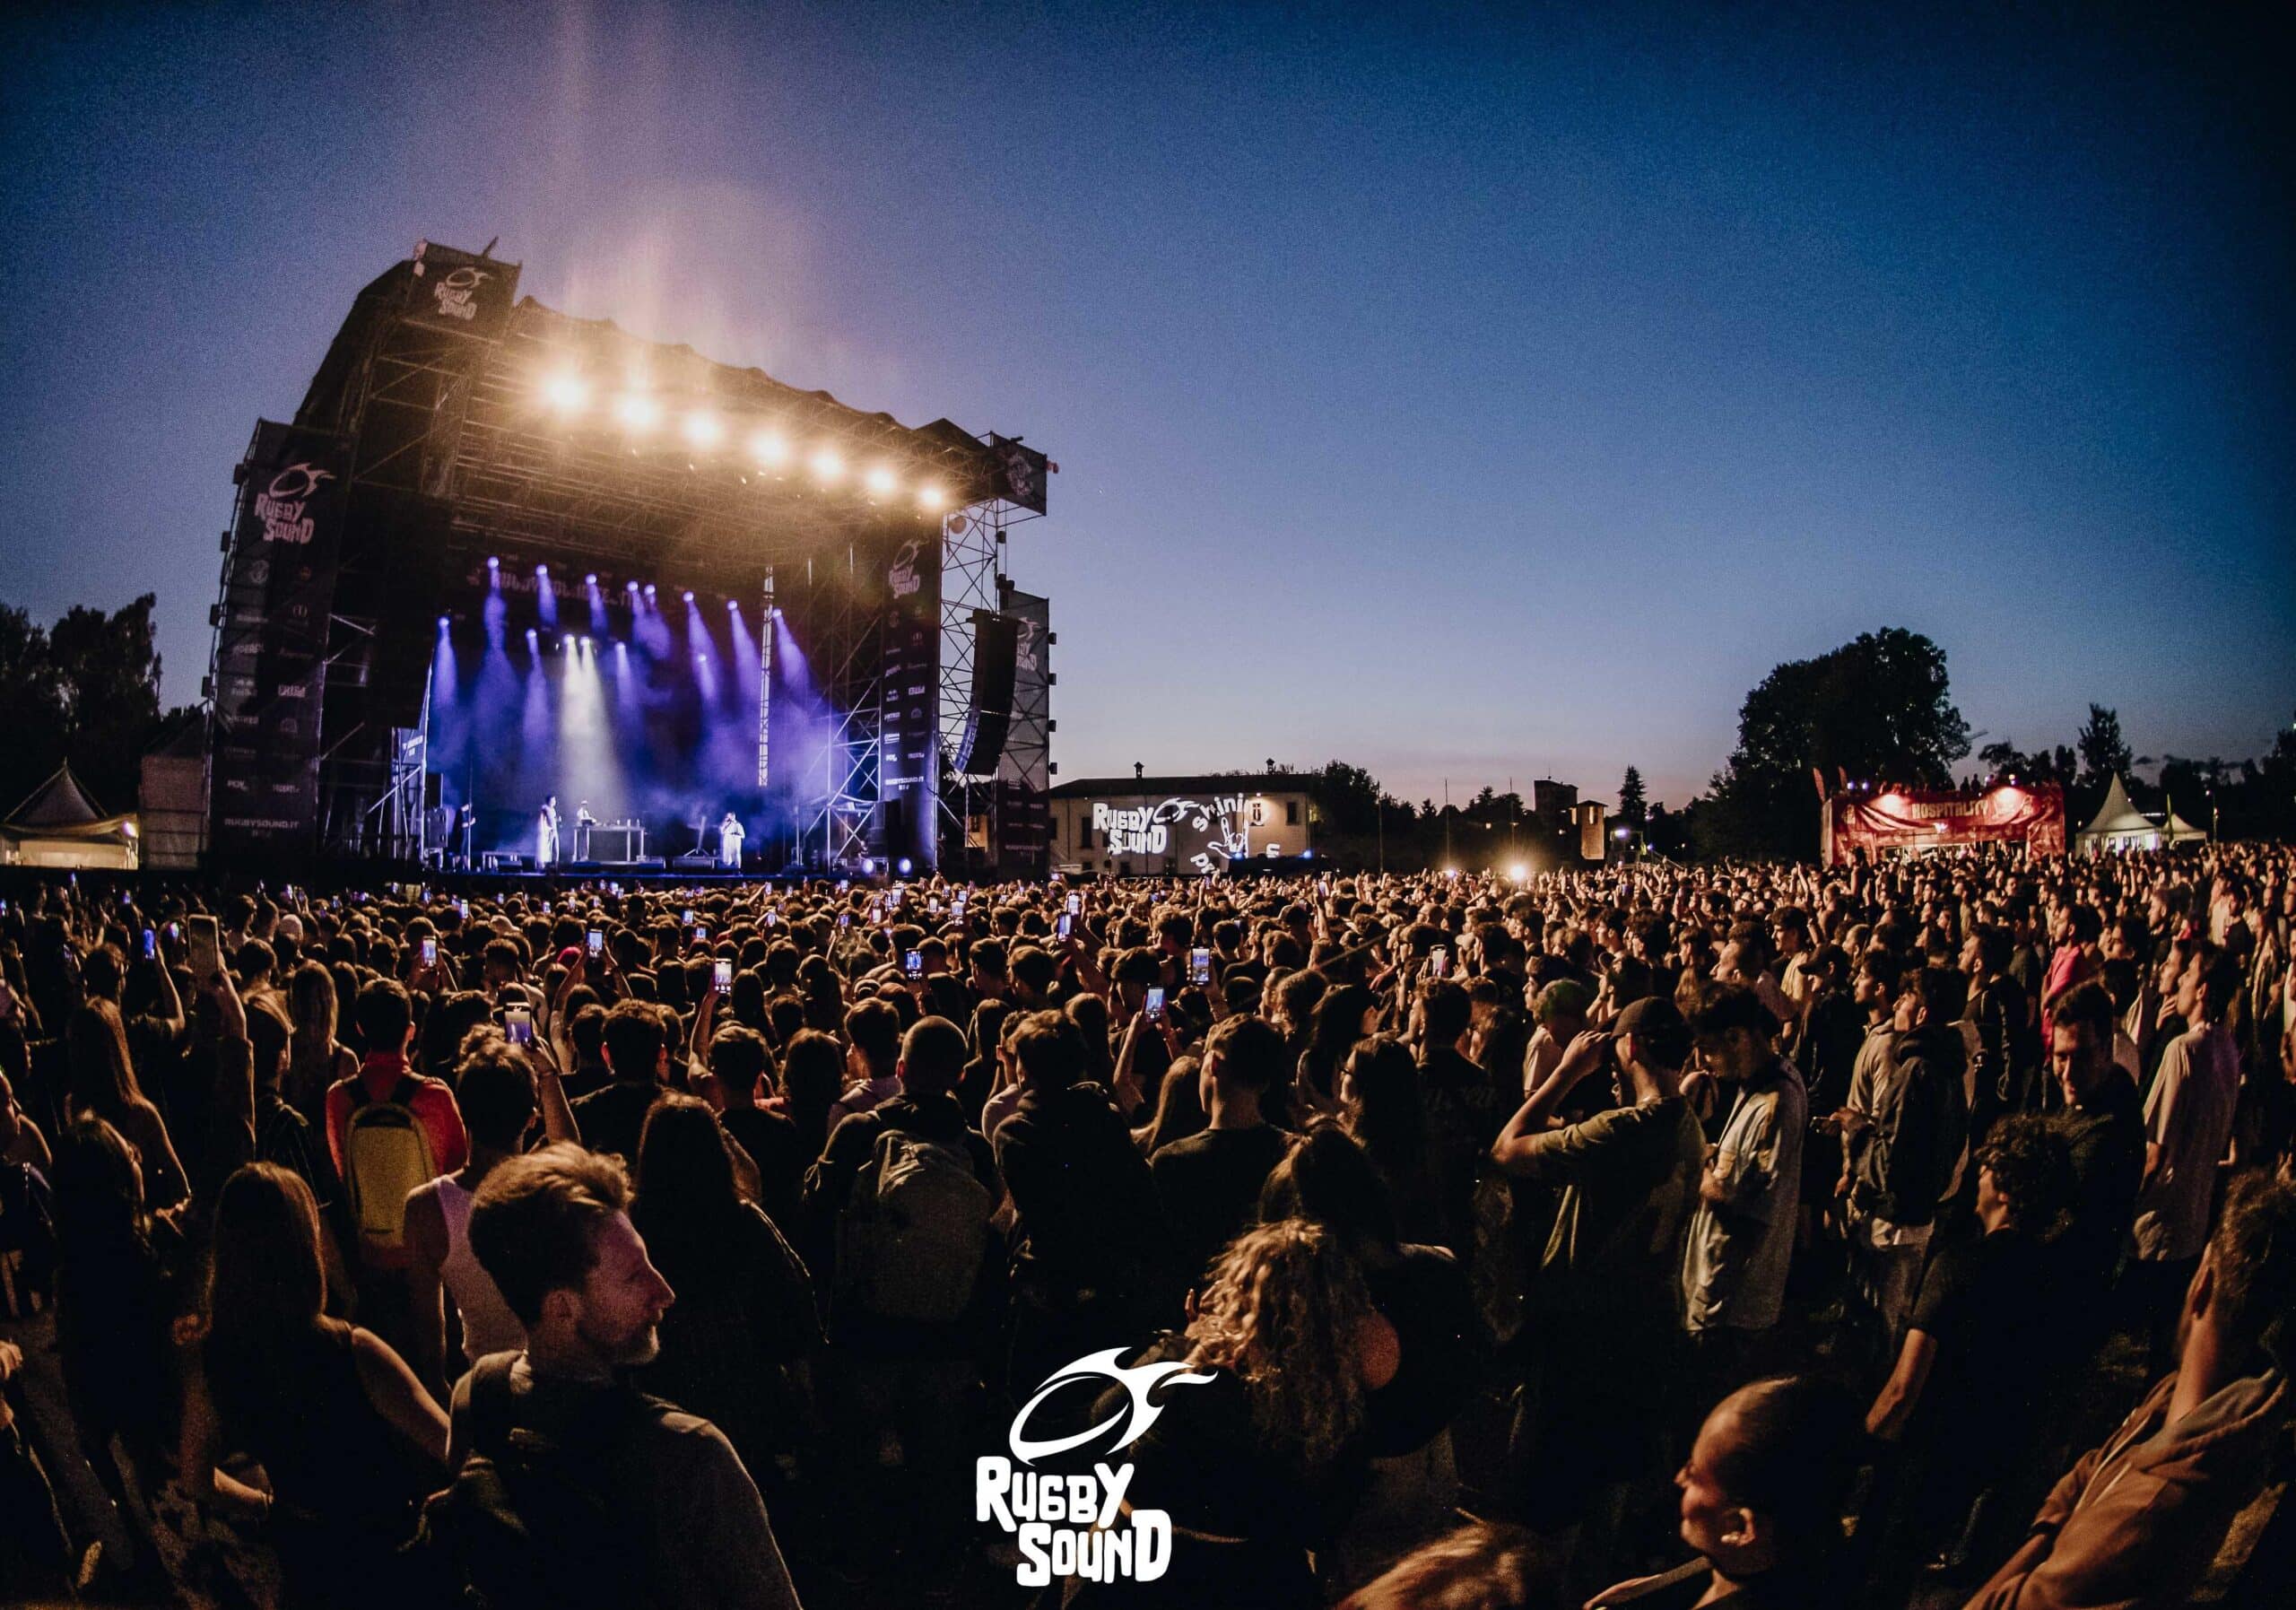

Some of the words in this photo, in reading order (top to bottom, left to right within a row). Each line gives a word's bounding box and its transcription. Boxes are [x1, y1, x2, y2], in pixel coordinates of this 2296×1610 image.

[254, 493, 306, 523] RUGBY
[263, 517, 314, 544] SOUND
[1093, 803, 1154, 833] RUGBY
[1911, 800, 1988, 820] HOSPITALITY
[1108, 824, 1167, 855] SOUND
